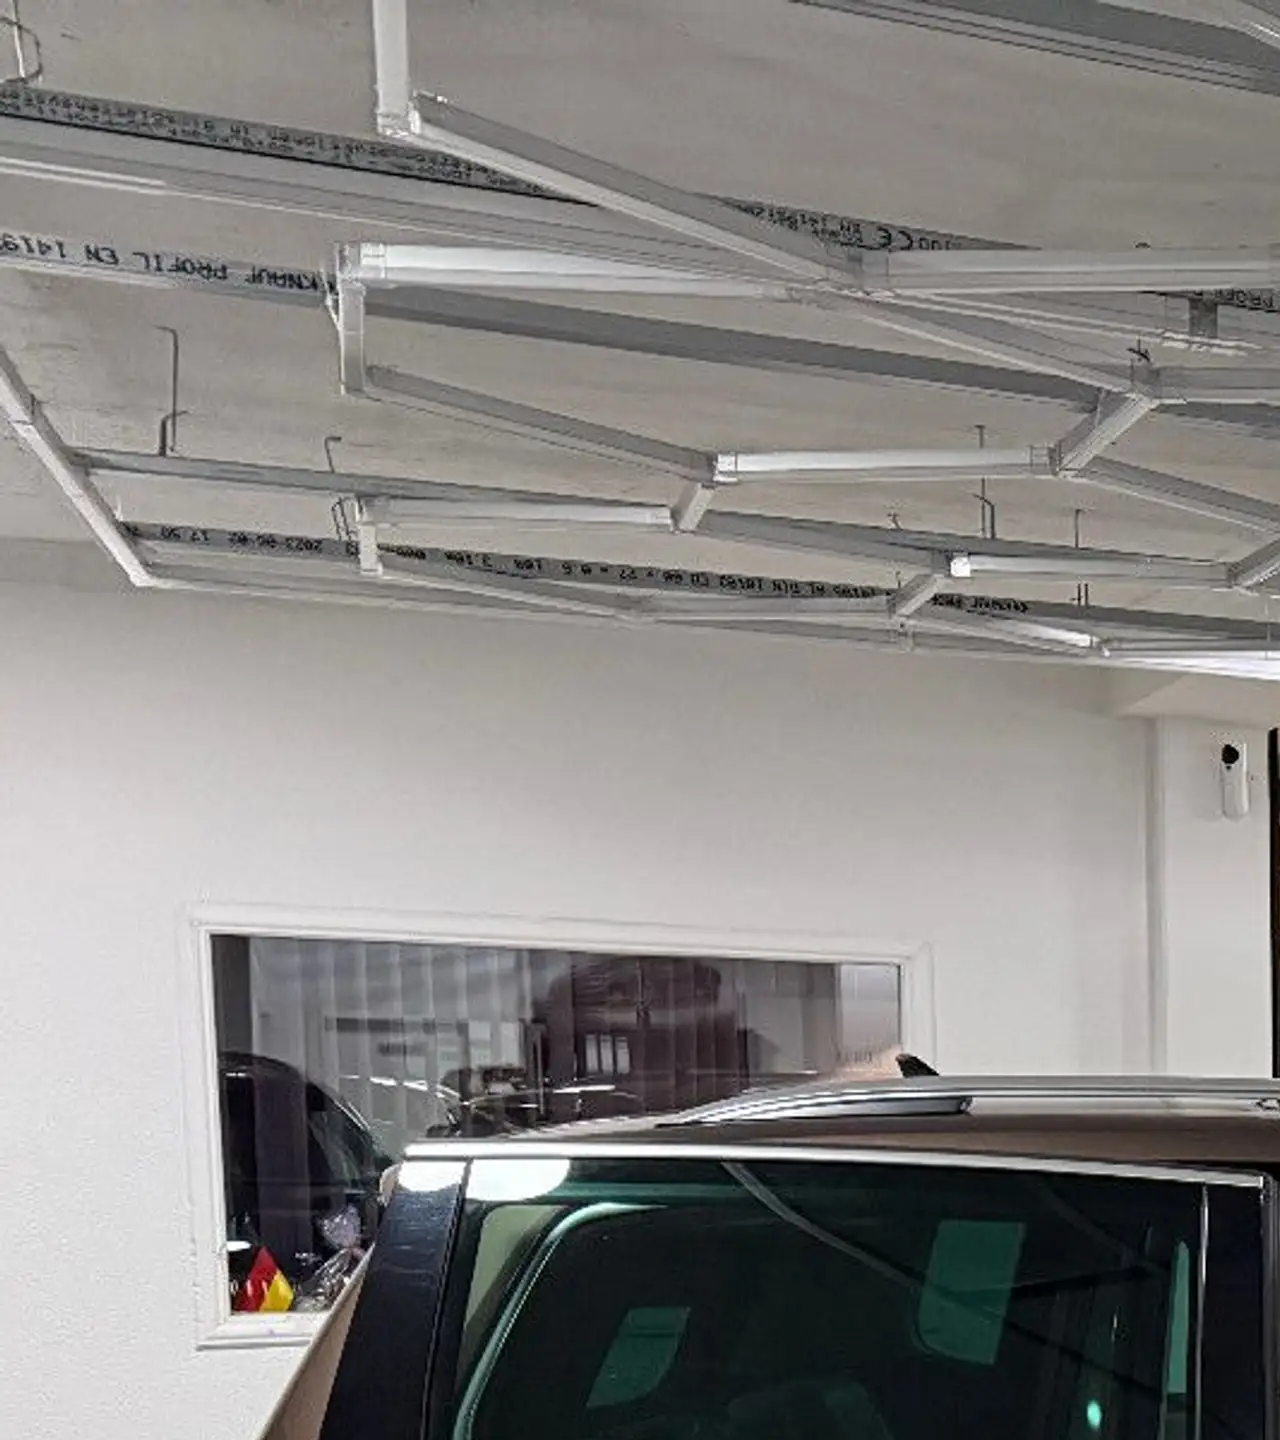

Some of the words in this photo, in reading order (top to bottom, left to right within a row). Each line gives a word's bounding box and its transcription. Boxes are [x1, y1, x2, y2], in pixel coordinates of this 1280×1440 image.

[0, 233, 67, 259] 1419
[85, 244, 119, 266] EN
[132, 252, 229, 281] PROFIL
